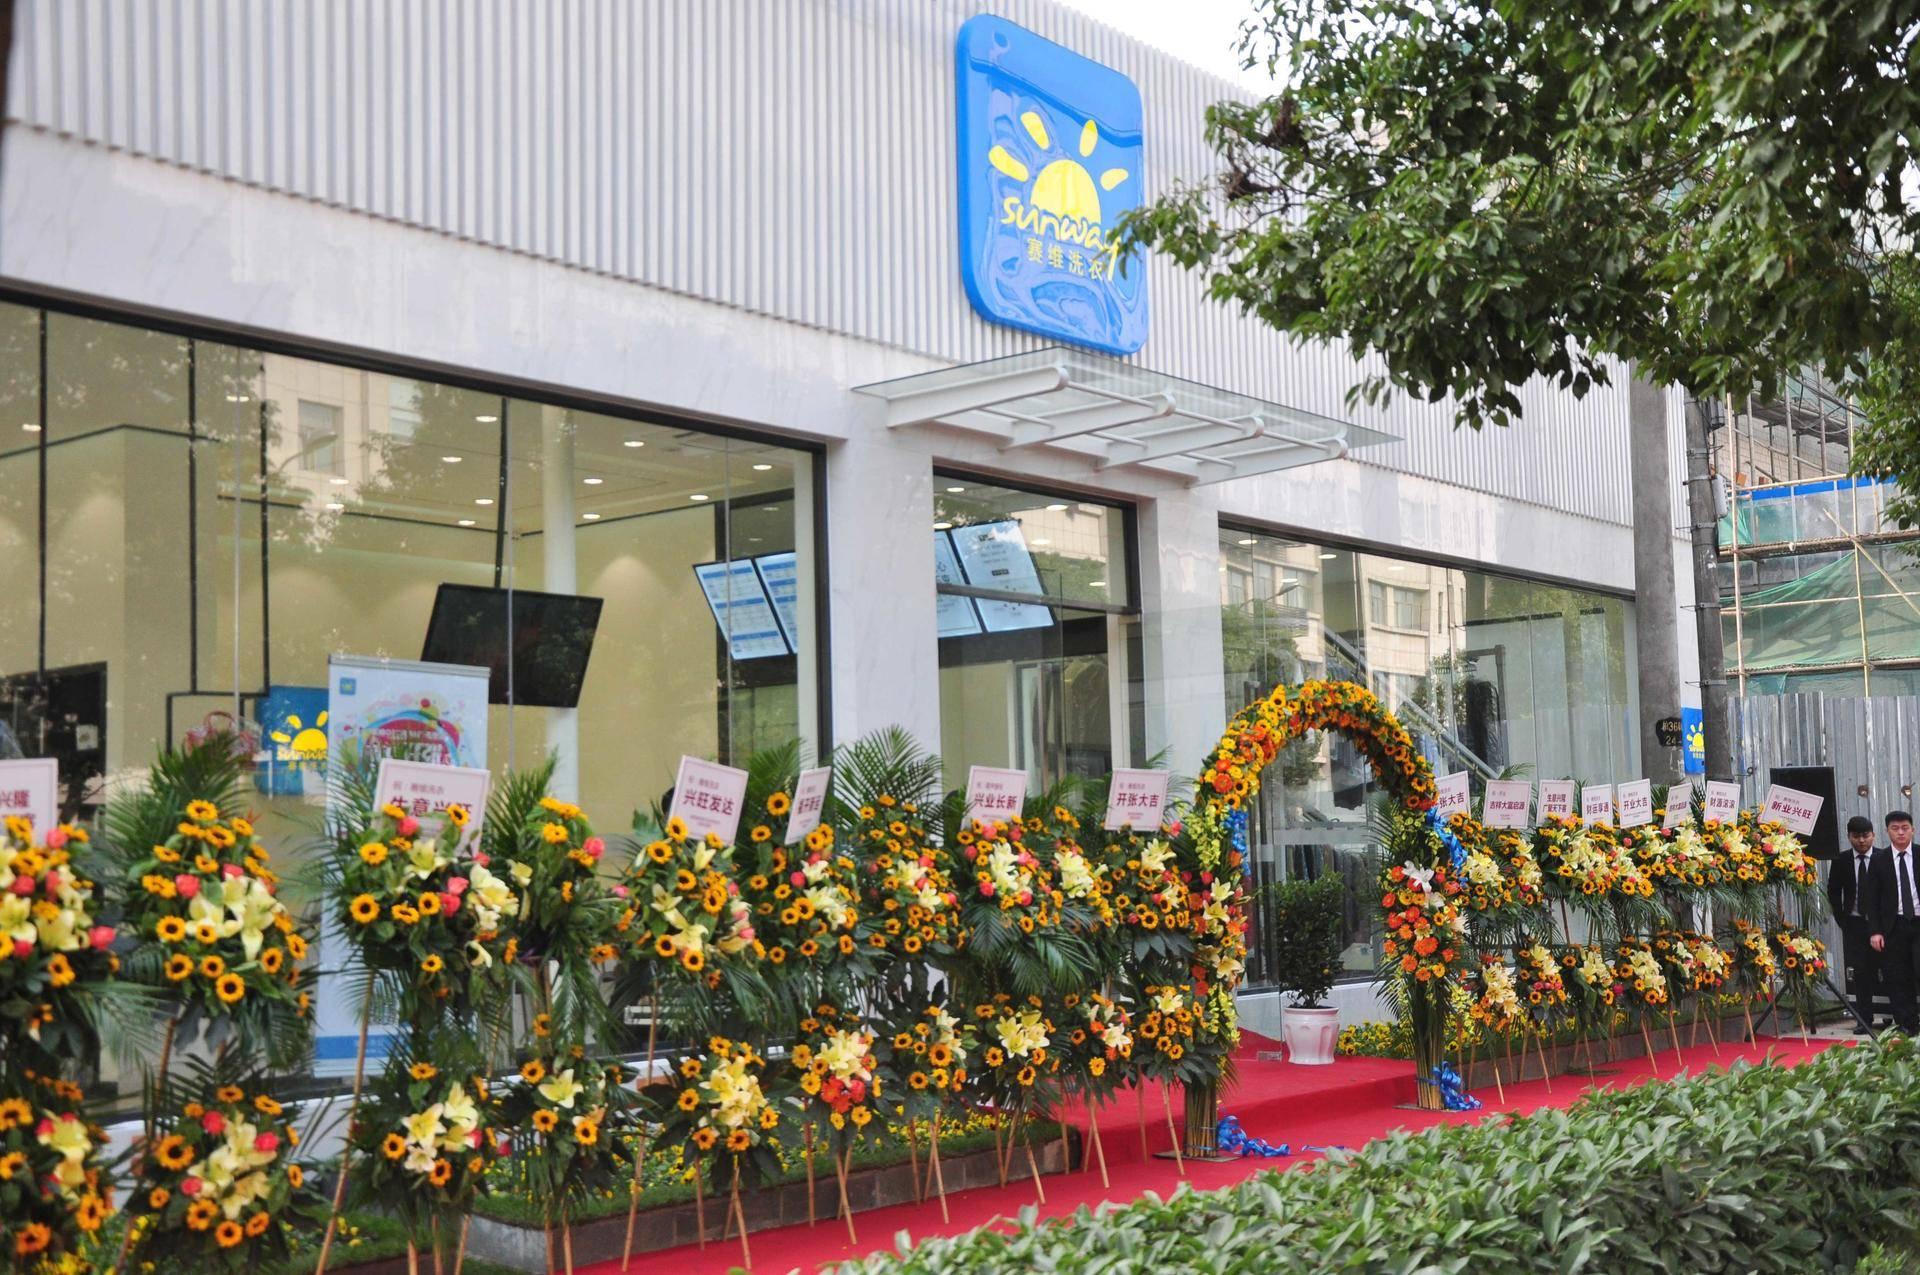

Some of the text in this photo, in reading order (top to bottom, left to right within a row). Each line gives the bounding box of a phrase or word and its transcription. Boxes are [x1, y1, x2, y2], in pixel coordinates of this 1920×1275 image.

[1001, 196, 1121, 281] sunway
[1028, 237, 1106, 281] 赛维洗衣
[683, 789, 734, 815] 兴旺发达
[1116, 793, 1160, 807] 开张大吉
[1438, 792, 1465, 808] 张大吉
[1624, 797, 1648, 810] 开业大吉
